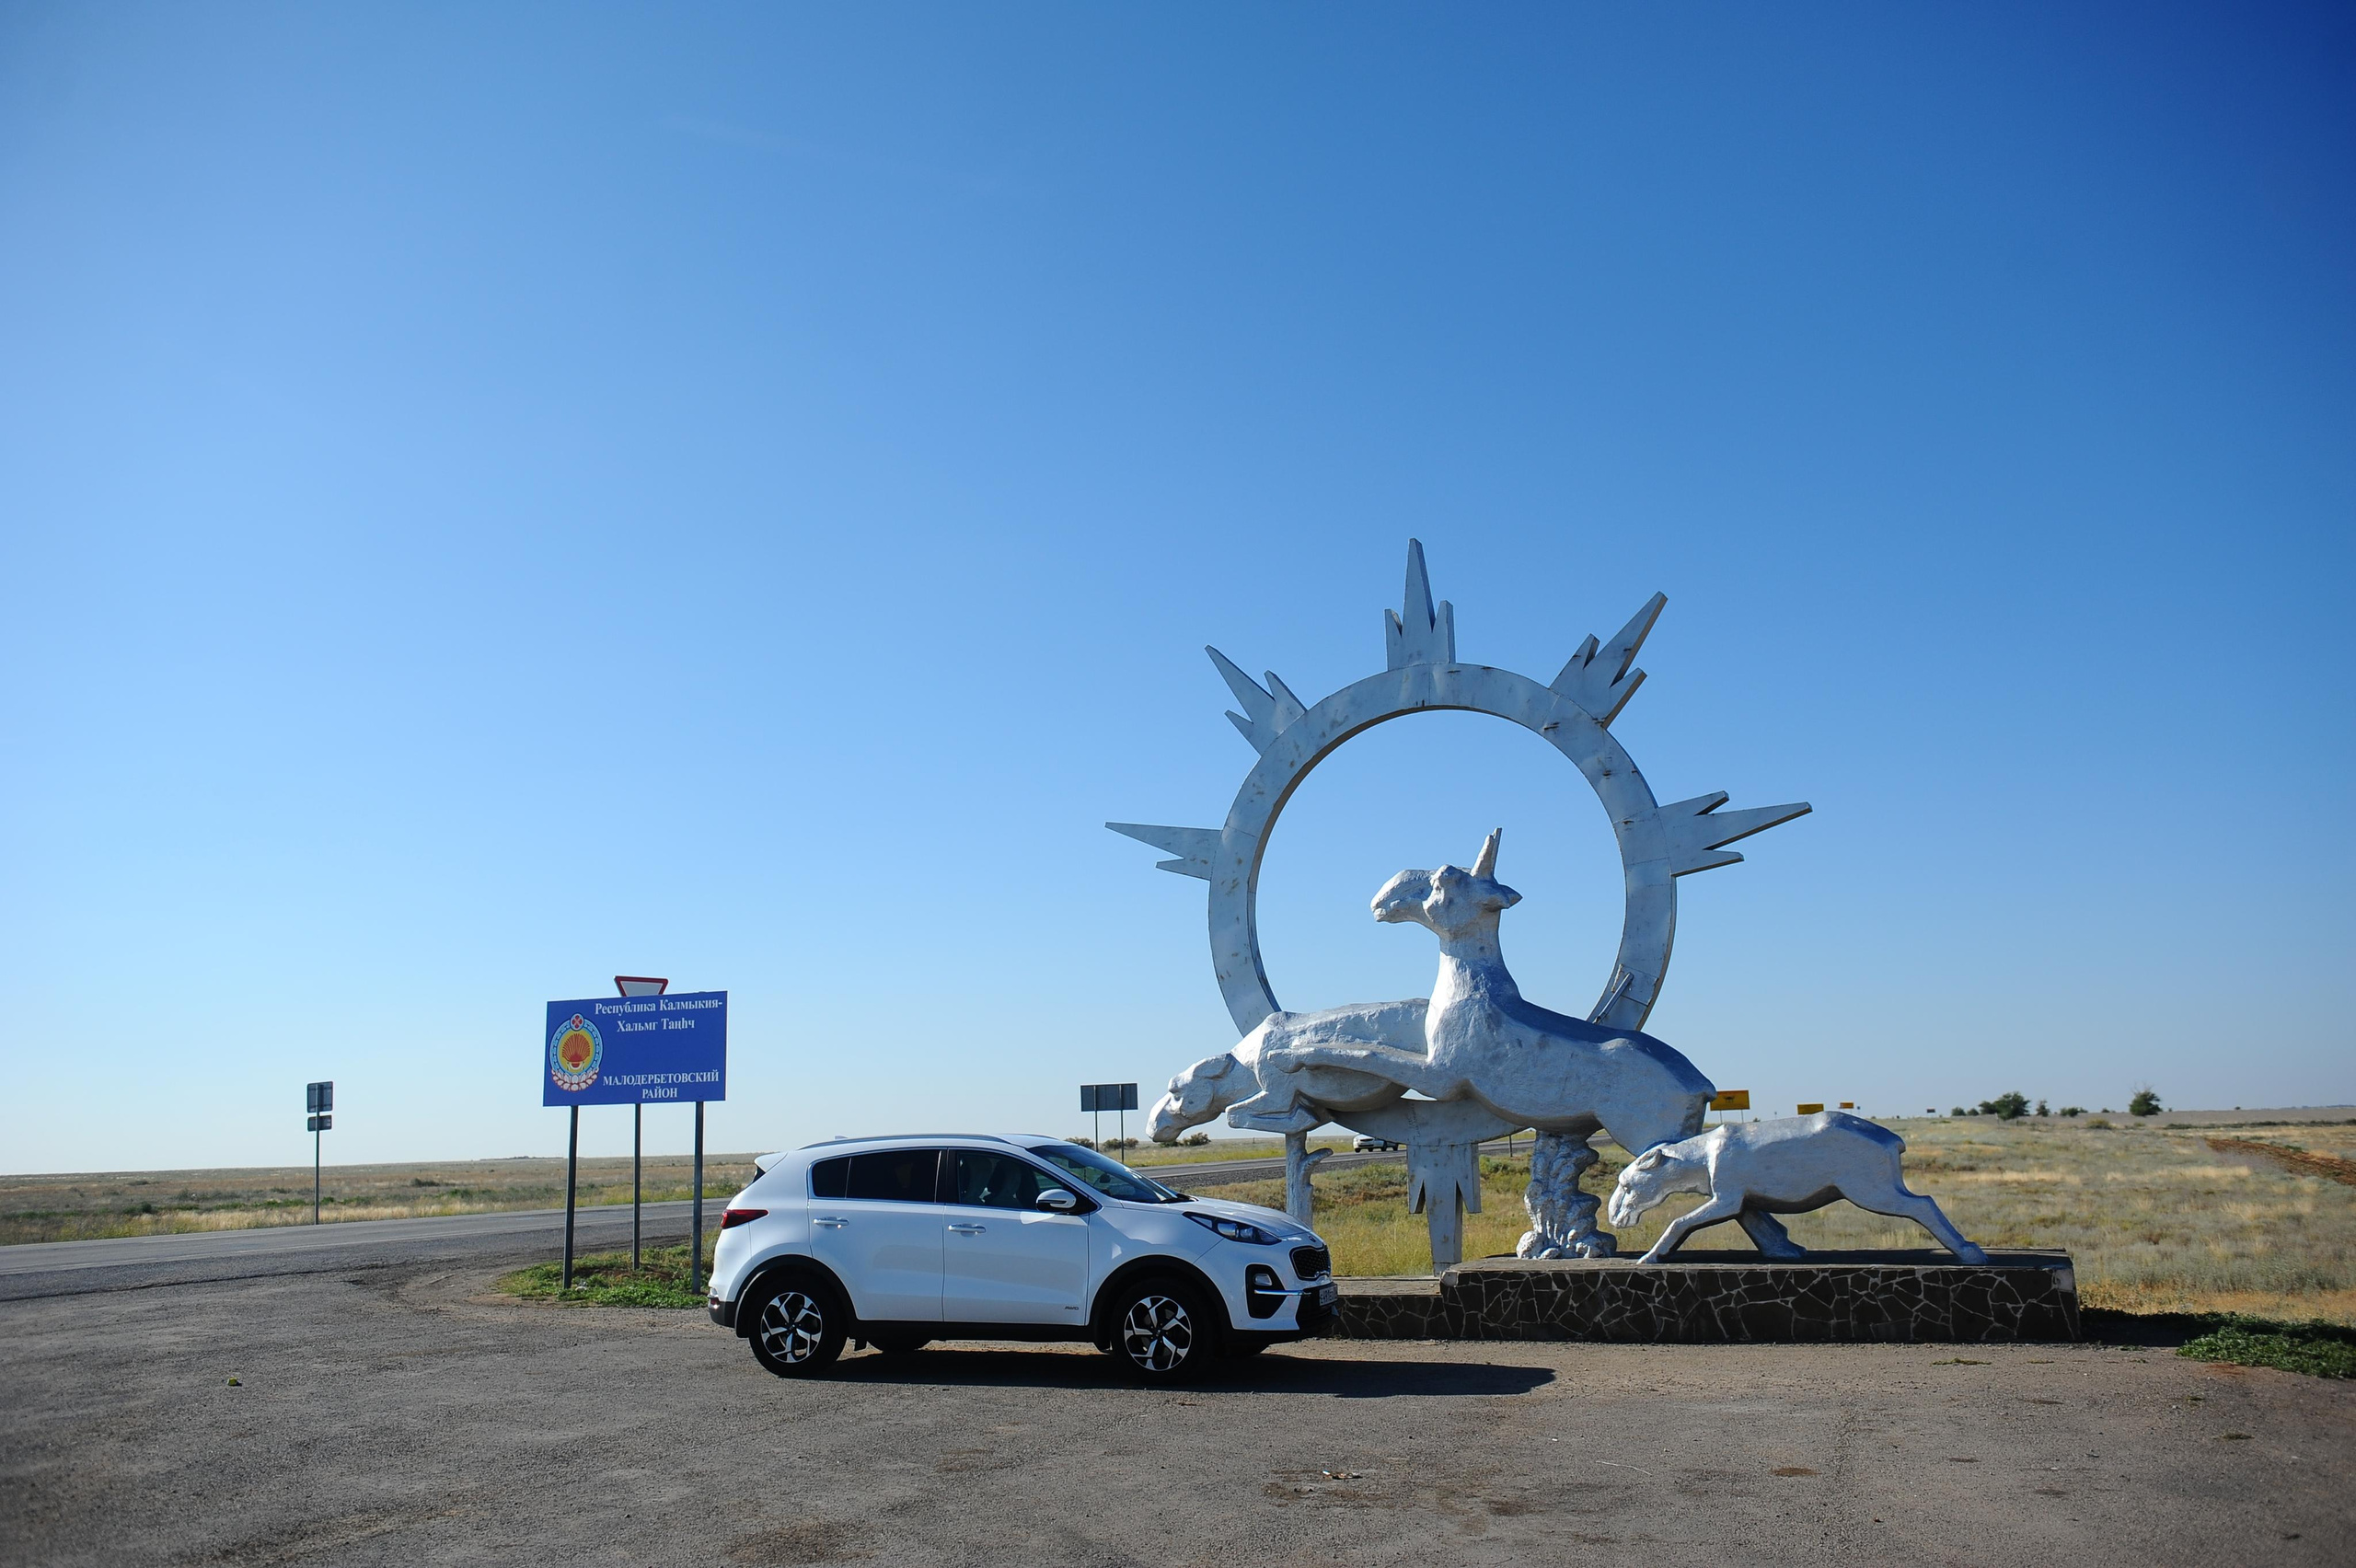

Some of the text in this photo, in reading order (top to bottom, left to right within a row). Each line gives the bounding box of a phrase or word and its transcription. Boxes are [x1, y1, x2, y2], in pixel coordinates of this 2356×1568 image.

[595, 998, 723, 1016] Республика Калмыкия-
[617, 1020, 658, 1032] Хальмг
[603, 1069, 720, 1086] МАЛОДЕРБЕТОВСКИЙ
[641, 1087, 678, 1100] РАЙОН
